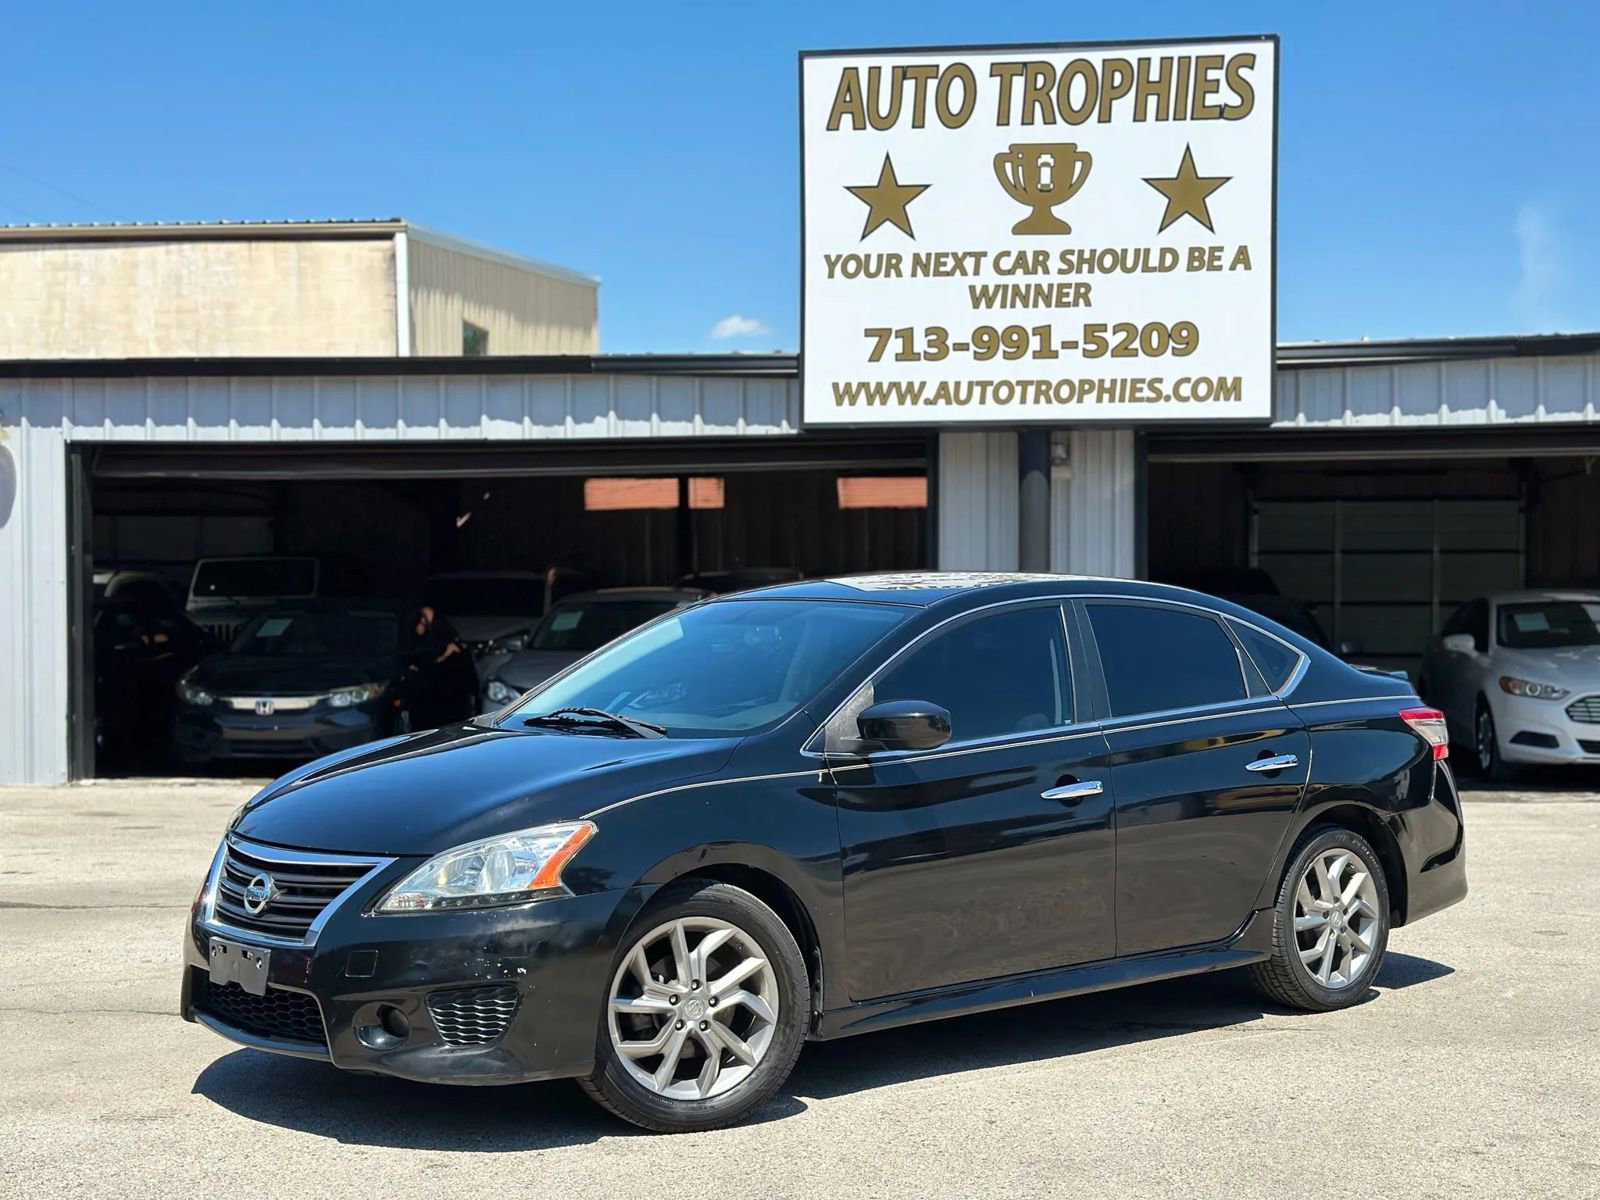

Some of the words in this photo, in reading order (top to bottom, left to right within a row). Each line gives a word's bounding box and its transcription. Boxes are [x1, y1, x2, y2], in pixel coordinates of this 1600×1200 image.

[826, 63, 977, 131] AUTO
[990, 53, 1256, 126] TROPHIES
[824, 253, 903, 279] YOUR
[911, 251, 987, 278] NEXT
[993, 250, 1050, 276] CAR
[1057, 247, 1179, 275] SHOULD
[1186, 246, 1224, 272] BE
[1229, 245, 1252, 271] A
[968, 282, 1092, 309] WINNER
[864, 321, 1199, 362] 713-991-5209
[832, 377, 1242, 406] WWW.AUTOTROPHIES.COM
